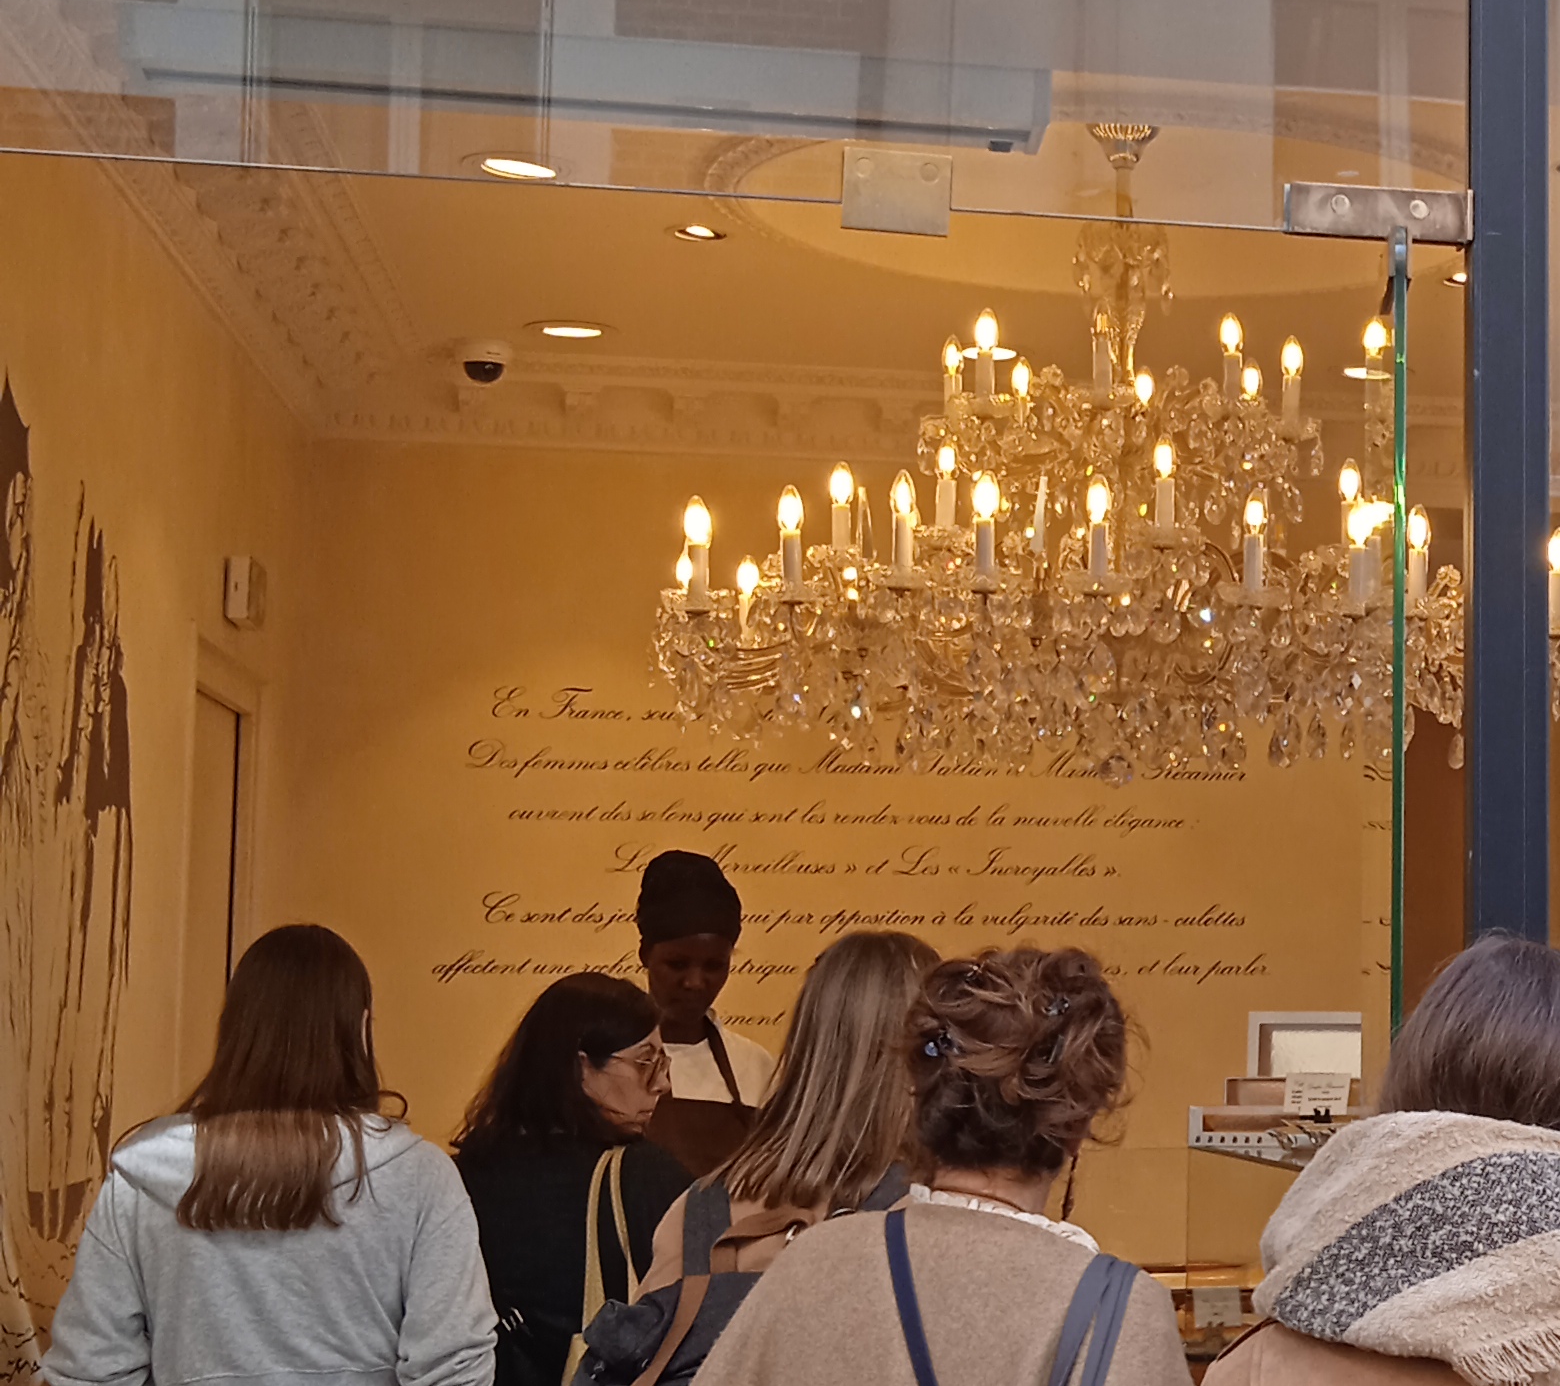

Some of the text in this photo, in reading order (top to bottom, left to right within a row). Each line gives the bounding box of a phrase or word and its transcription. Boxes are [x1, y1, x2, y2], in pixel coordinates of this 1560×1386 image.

[491, 685, 530, 719] En
[540, 687, 632, 722] France,
[641, 708, 685, 722] sou
[466, 738, 517, 770] Des
[514, 745, 609, 778] femmes
[697, 747, 750, 774] telles
[749, 761, 792, 783] que
[507, 805, 599, 822] ouvrent
[600, 800, 632, 822] des
[636, 798, 702, 822] salons
[702, 808, 746, 832] qui
[748, 807, 798, 825] sont
[800, 800, 826, 825] les
[955, 804, 982, 827] de
[986, 803, 1010, 827] la
[1012, 804, 1106, 828] nouvelle
[865, 858, 890, 876] et
[892, 844, 941, 877] Les
[966, 846, 1098, 887] Incroyables
[481, 890, 521, 924] Ce
[520, 906, 573, 924] sont
[572, 901, 605, 924] des
[594, 907, 639, 934] jeu
[765, 908, 814, 934] par
[818, 908, 926, 935] opposition
[931, 908, 947, 927] à
[953, 901, 978, 927] la
[981, 901, 1079, 936] vulgarité
[1078, 904, 1110, 928] des
[1112, 913, 1160, 928] sans
[1173, 903, 1247, 929] culottes
[431, 949, 533, 984] affectent
[533, 962, 577, 975] une
[1137, 958, 1162, 976] et
[1162, 952, 1201, 976] leur
[1195, 952, 1272, 985] parler
